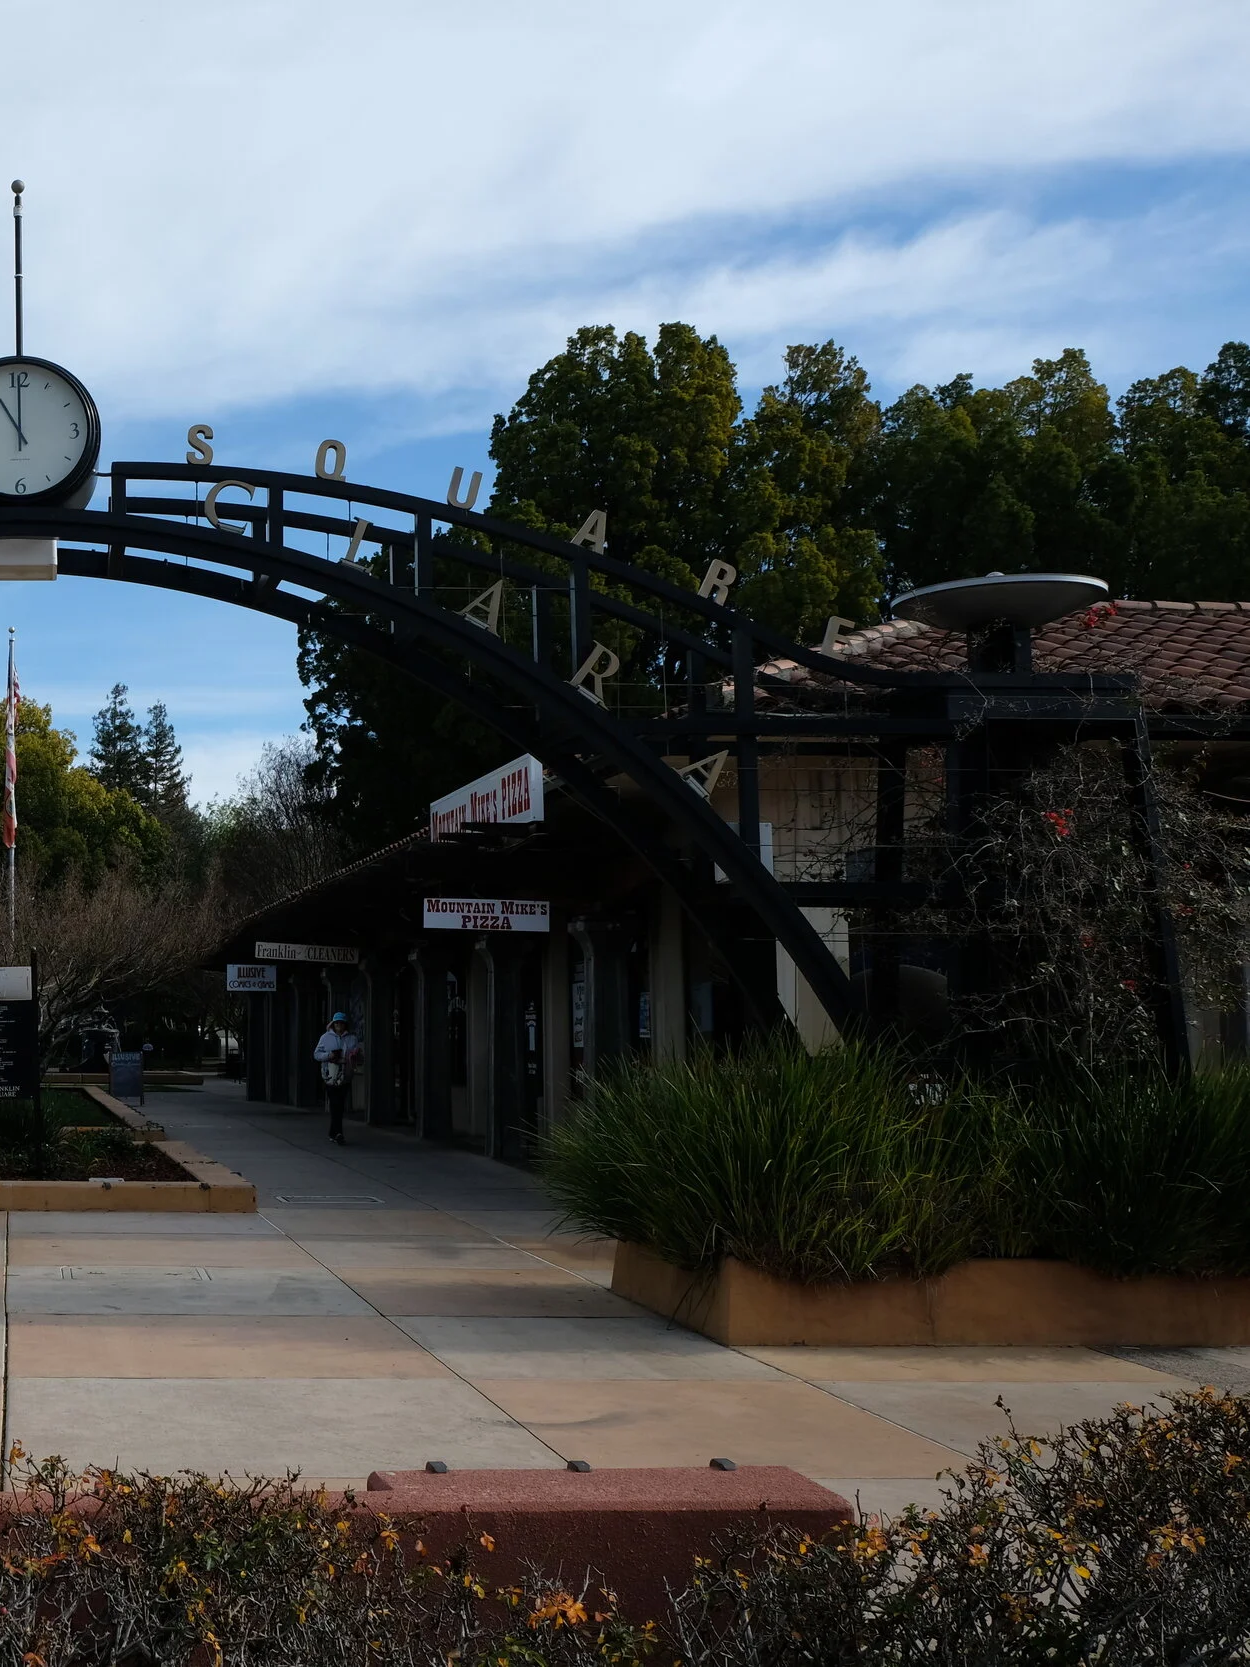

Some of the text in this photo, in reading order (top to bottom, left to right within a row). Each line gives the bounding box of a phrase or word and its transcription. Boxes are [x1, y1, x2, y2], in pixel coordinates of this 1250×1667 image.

[9, 371, 30, 388] 12
[69, 422, 80, 440] 3
[14, 477, 26, 494] 6
[186, 423, 856, 660] SQUARE
[470, 791, 498, 824] MIKE'S
[501, 766, 531, 820] PIZZA
[427, 899, 548, 915] MOUNTAIN MIKE'S
[461, 915, 512, 929] PIZZA
[257, 944, 355, 961] Franklin CLEANERS
